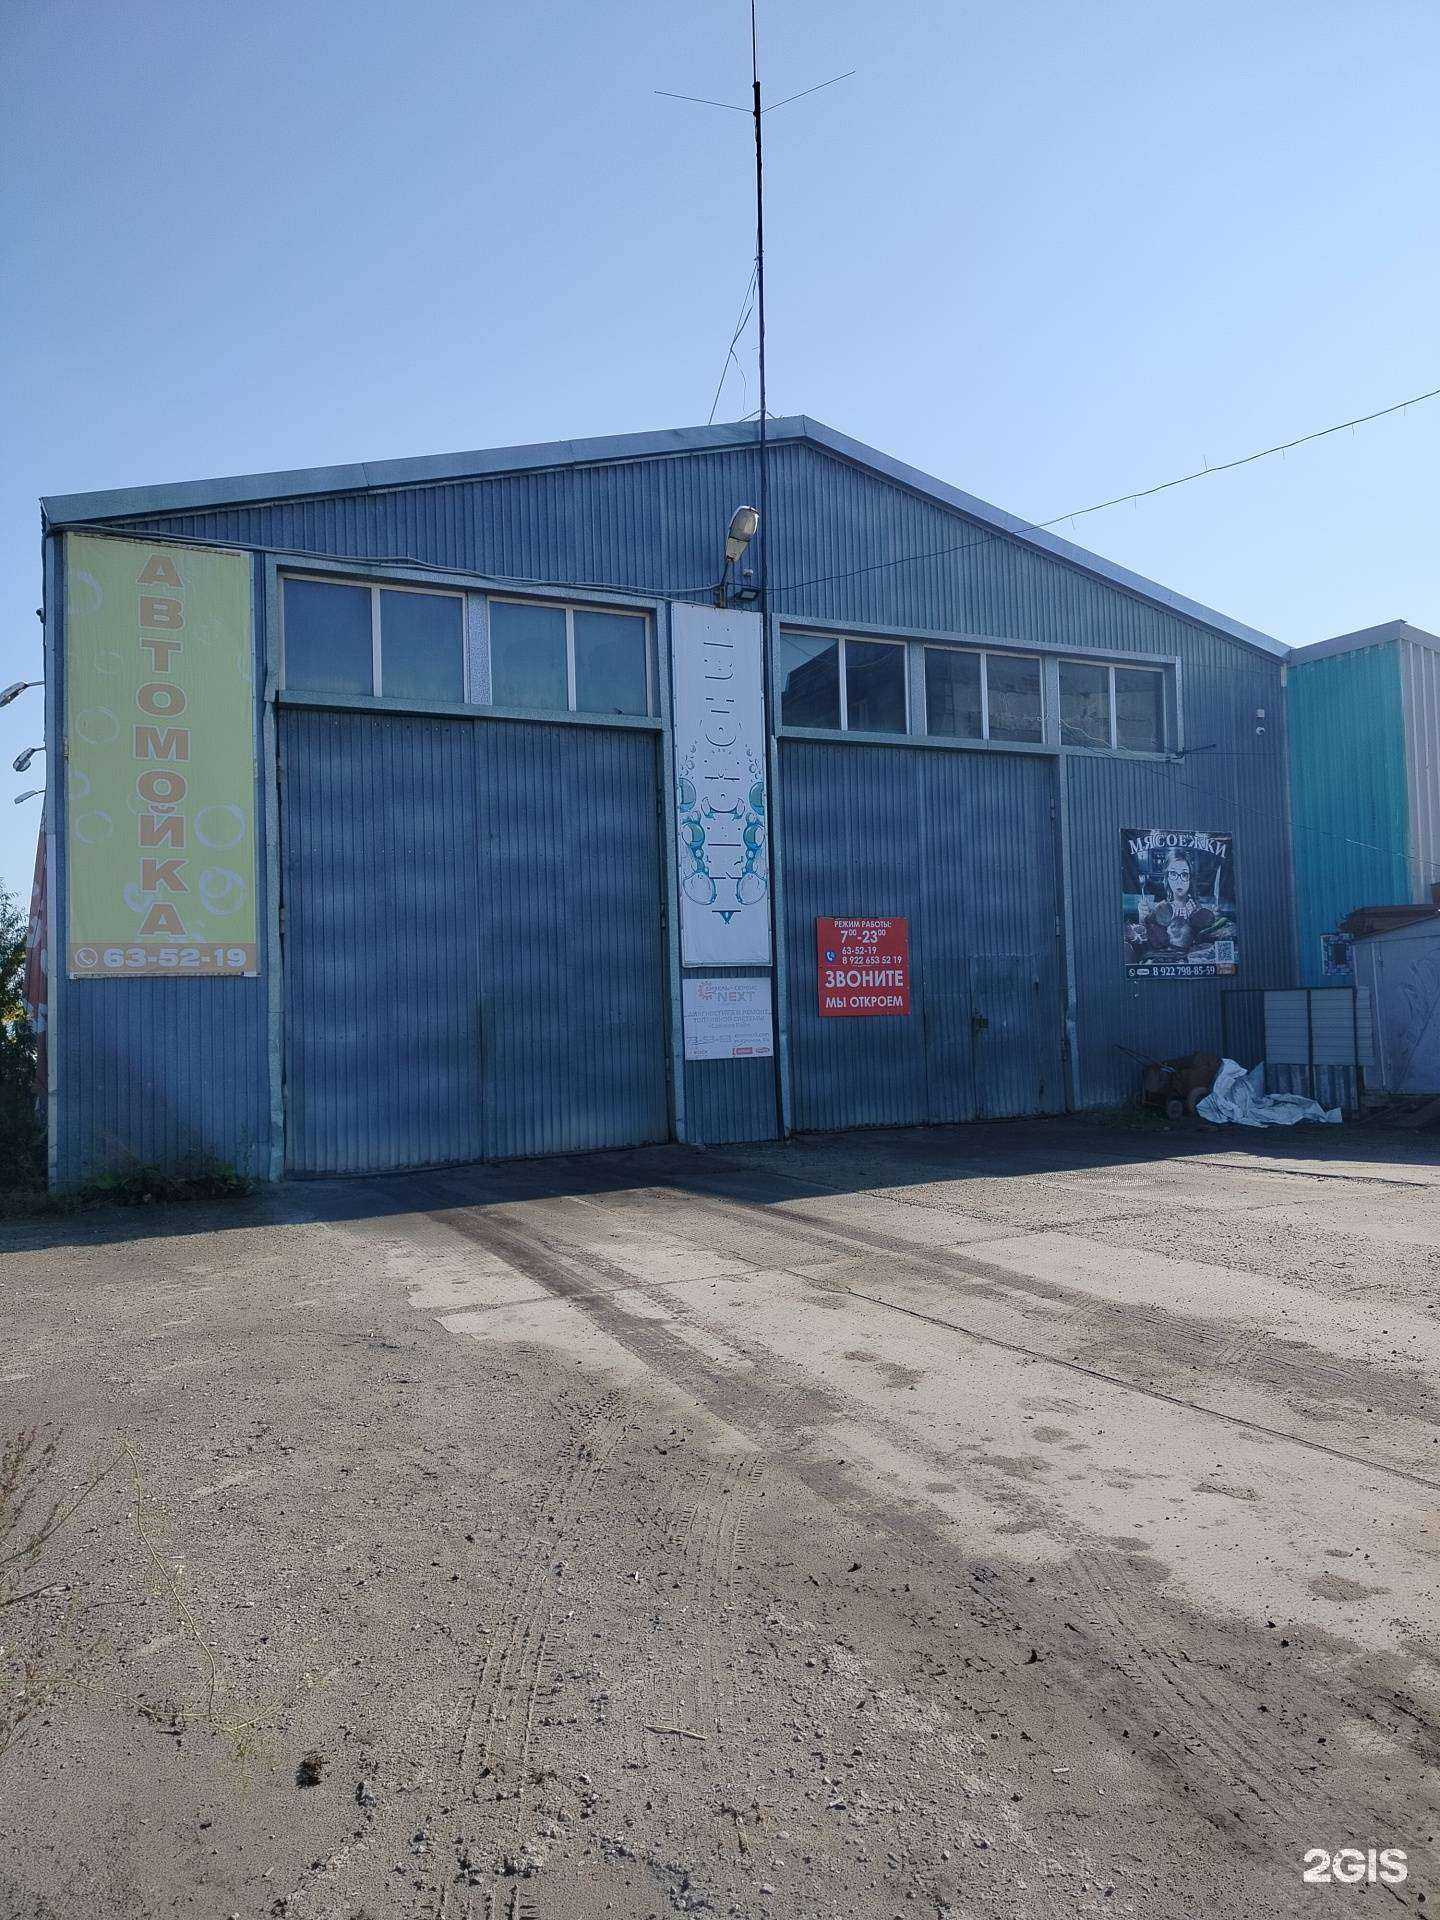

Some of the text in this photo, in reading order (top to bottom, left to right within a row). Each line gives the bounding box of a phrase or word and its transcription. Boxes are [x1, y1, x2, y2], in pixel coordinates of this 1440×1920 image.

[132, 554, 190, 937] АВТОМОЙКА
[1128, 833, 1227, 858] МЯСОЕЖКИ
[834, 920, 860, 928] РЕЖИМ
[841, 946, 877, 955] 63-52-19
[102, 948, 247, 968] 63-52-19
[849, 956, 864, 965] 922
[893, 955, 902, 964] 19
[825, 970, 904, 988] ЗВОНИТЕ
[717, 991, 755, 1002] NEXT
[825, 995, 903, 1008] МЫ ОТКРОЕМ
